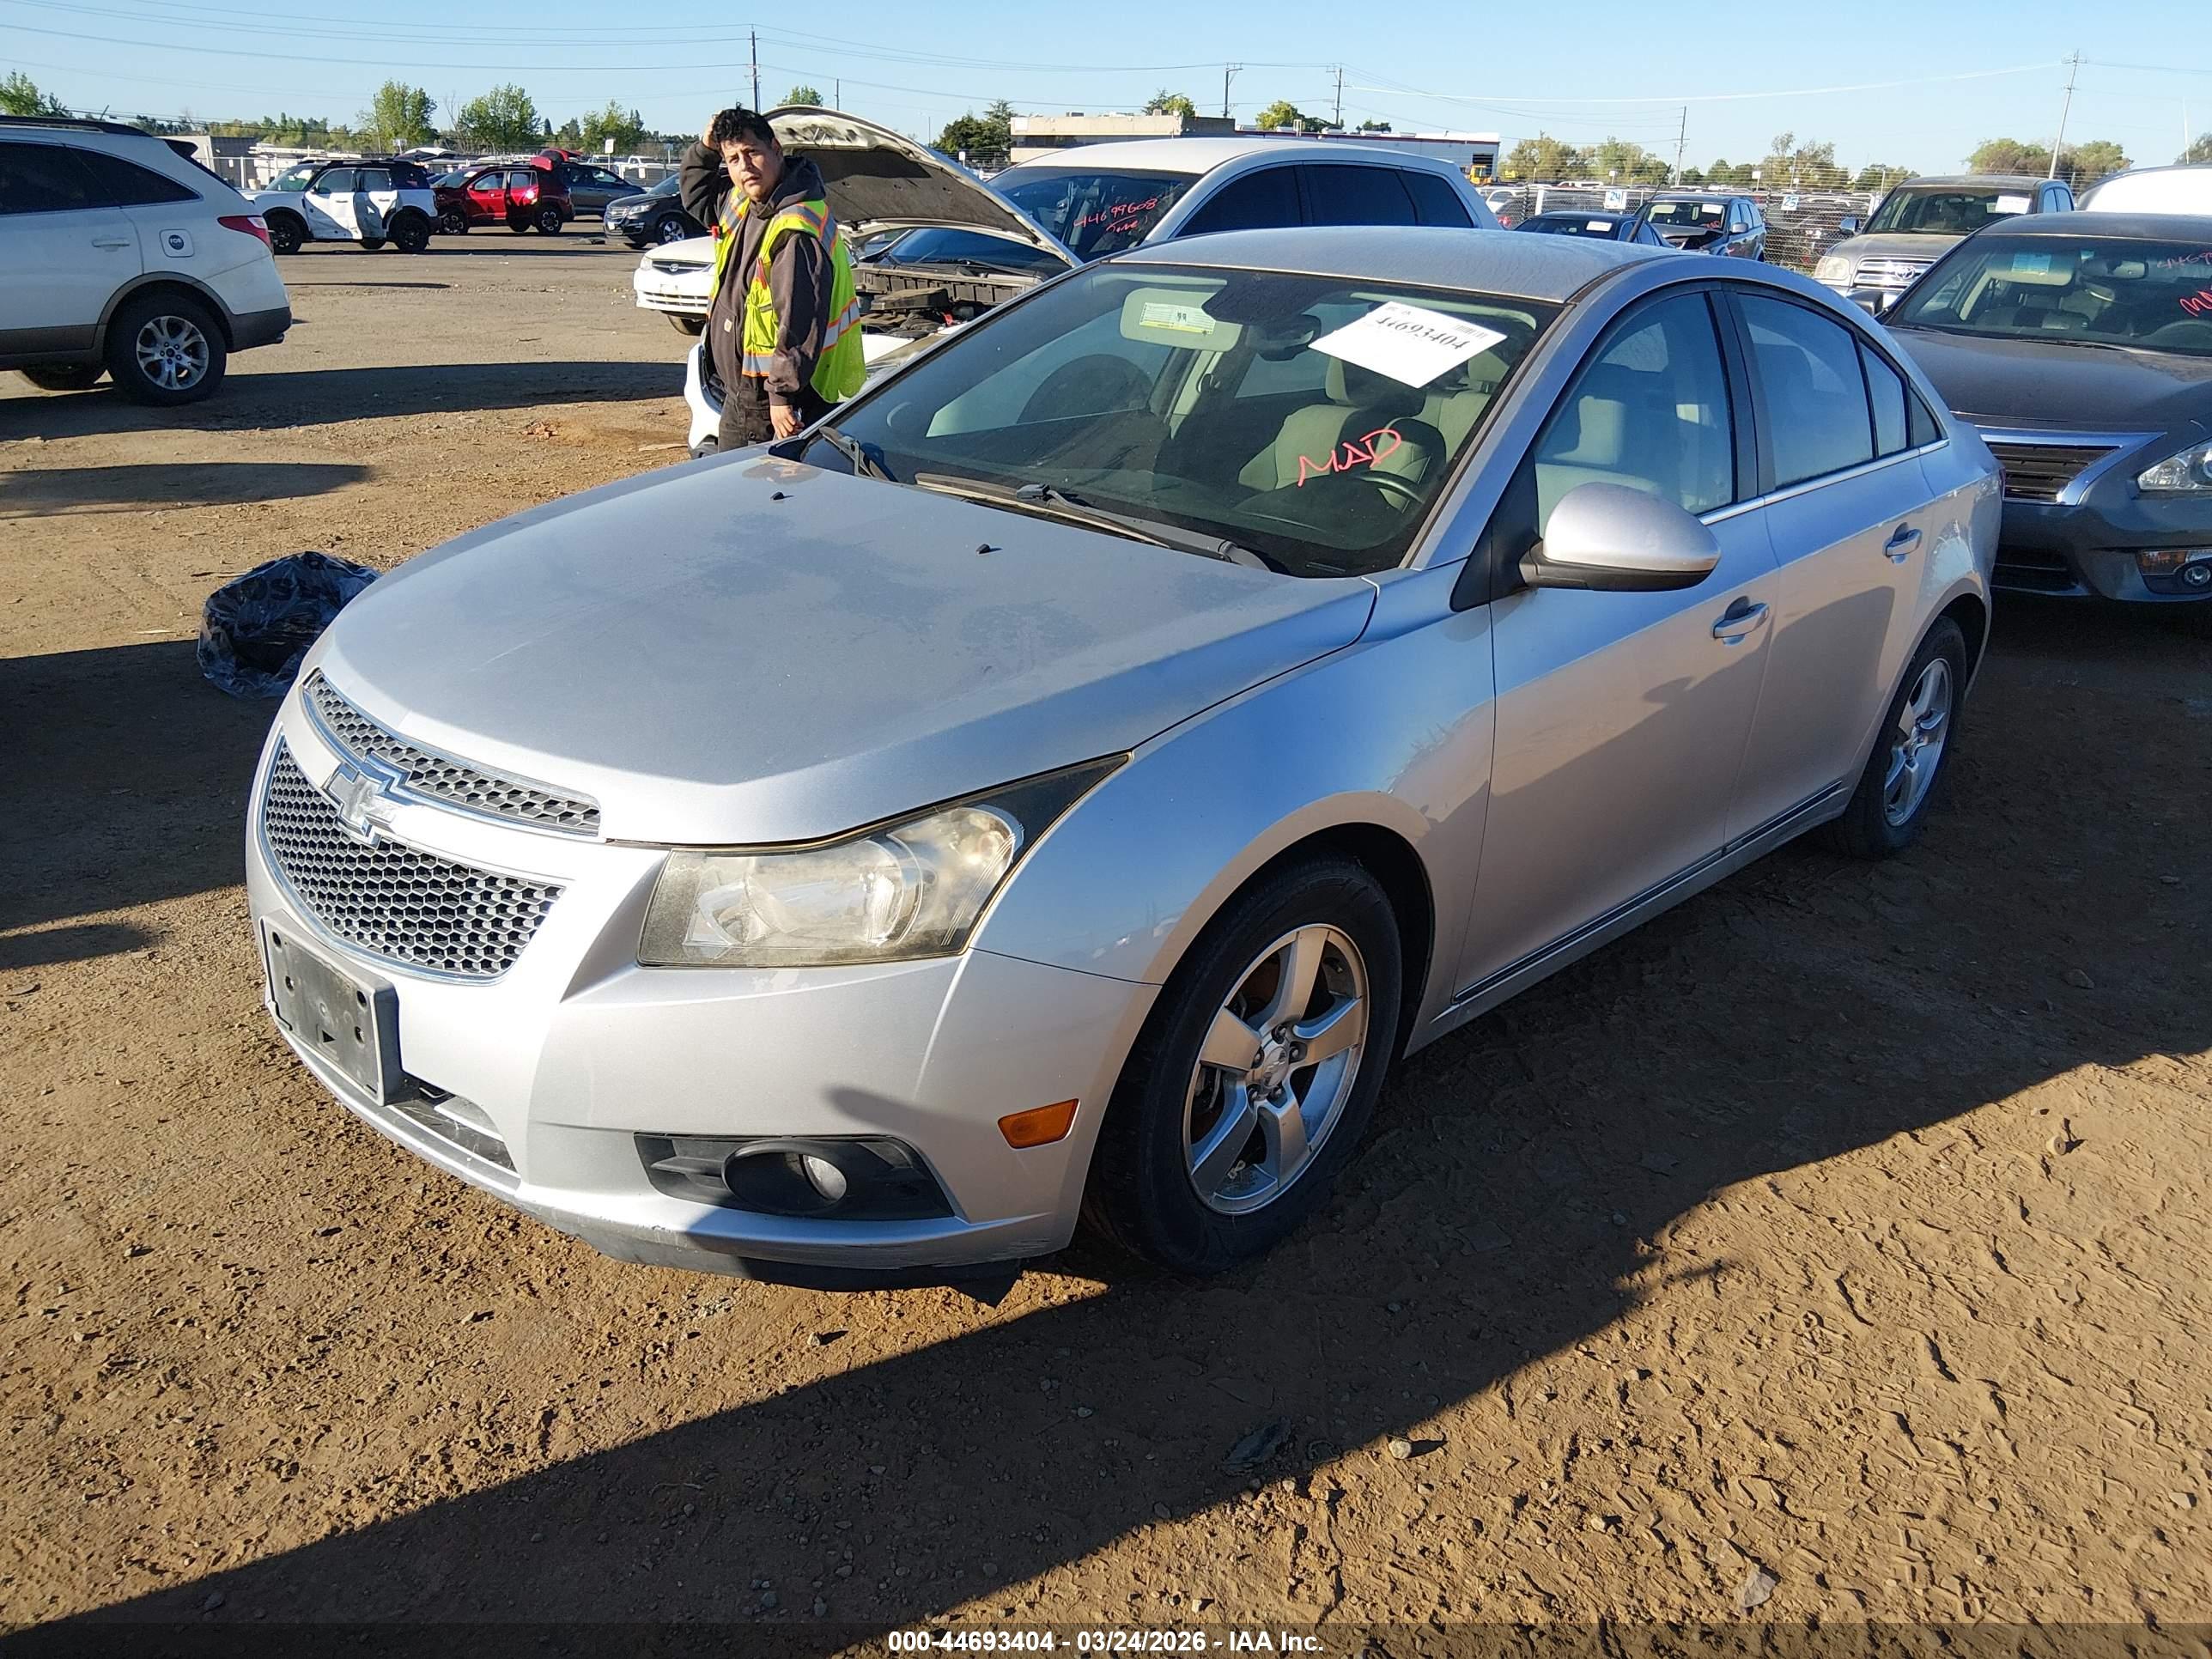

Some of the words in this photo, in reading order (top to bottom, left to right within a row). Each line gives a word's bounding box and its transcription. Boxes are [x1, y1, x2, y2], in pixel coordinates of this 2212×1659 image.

[1610, 191, 1621, 203] 24
[1784, 197, 1797, 207] 25
[1297, 429, 1401, 487] MAD
